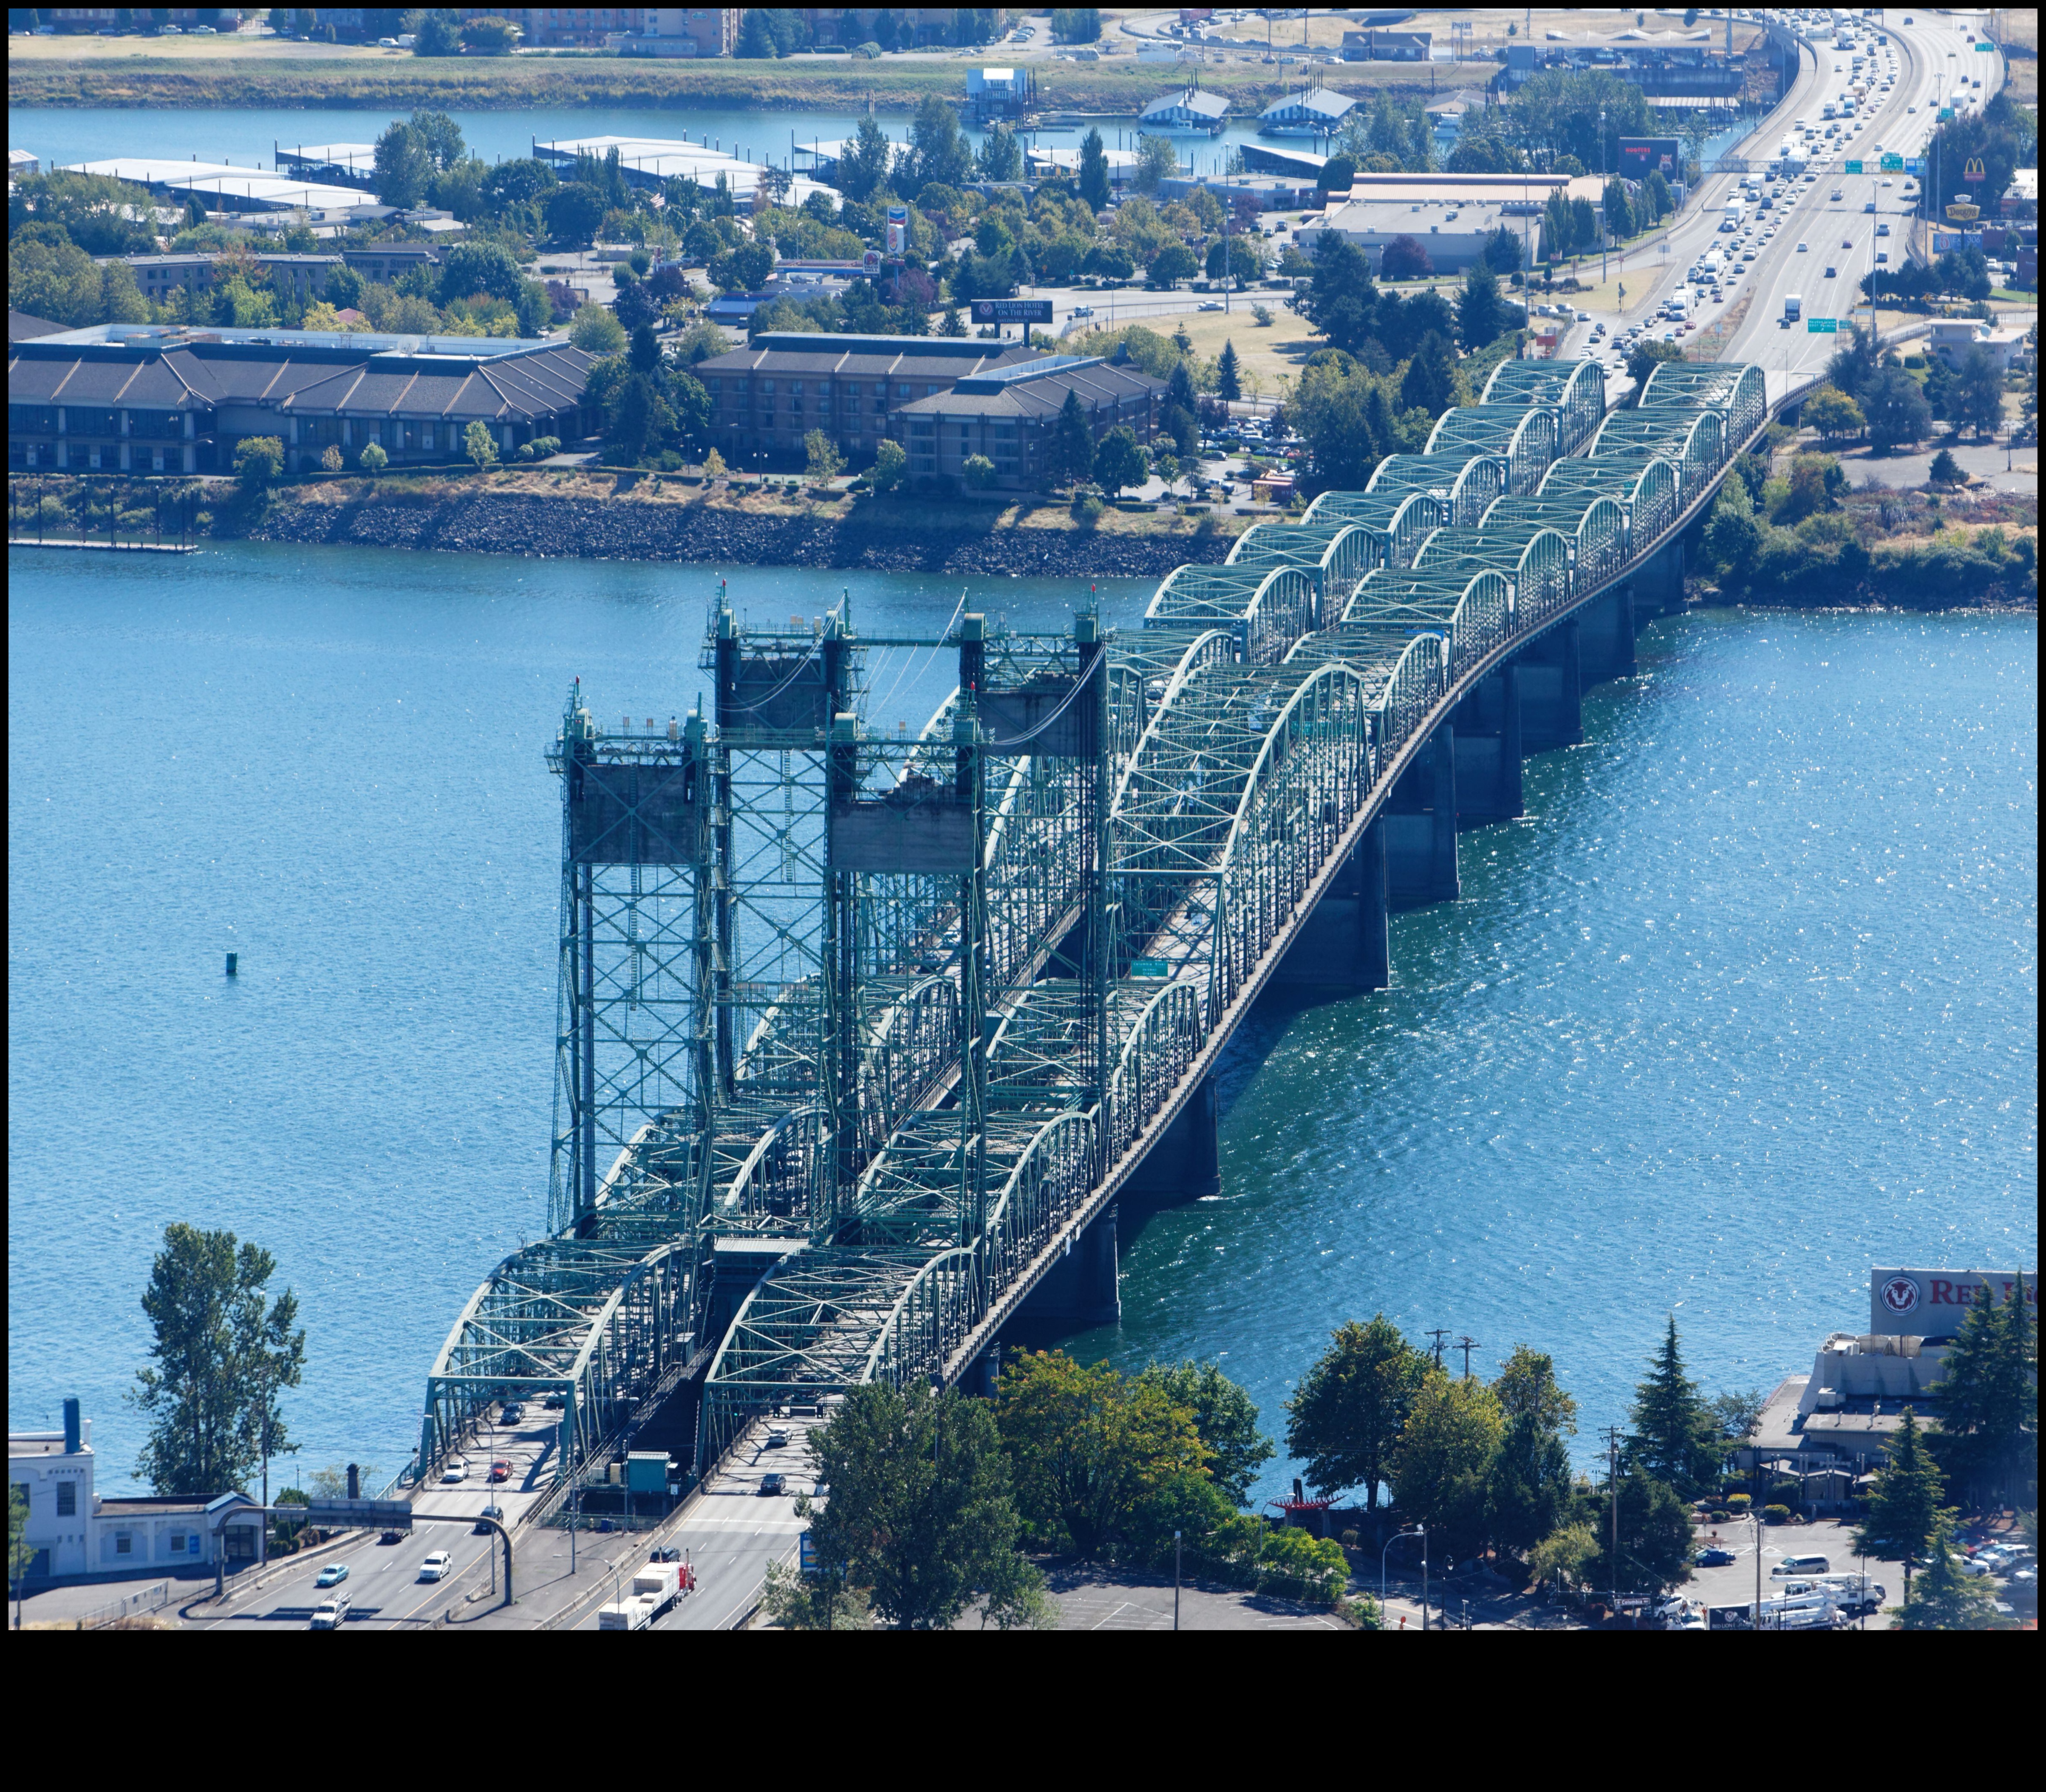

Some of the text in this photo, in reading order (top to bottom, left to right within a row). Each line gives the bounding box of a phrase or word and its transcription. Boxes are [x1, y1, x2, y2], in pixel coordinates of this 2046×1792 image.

[1948, 207, 1977, 219] Denny's
[345, 257, 424, 268] OXFORD SUIT
